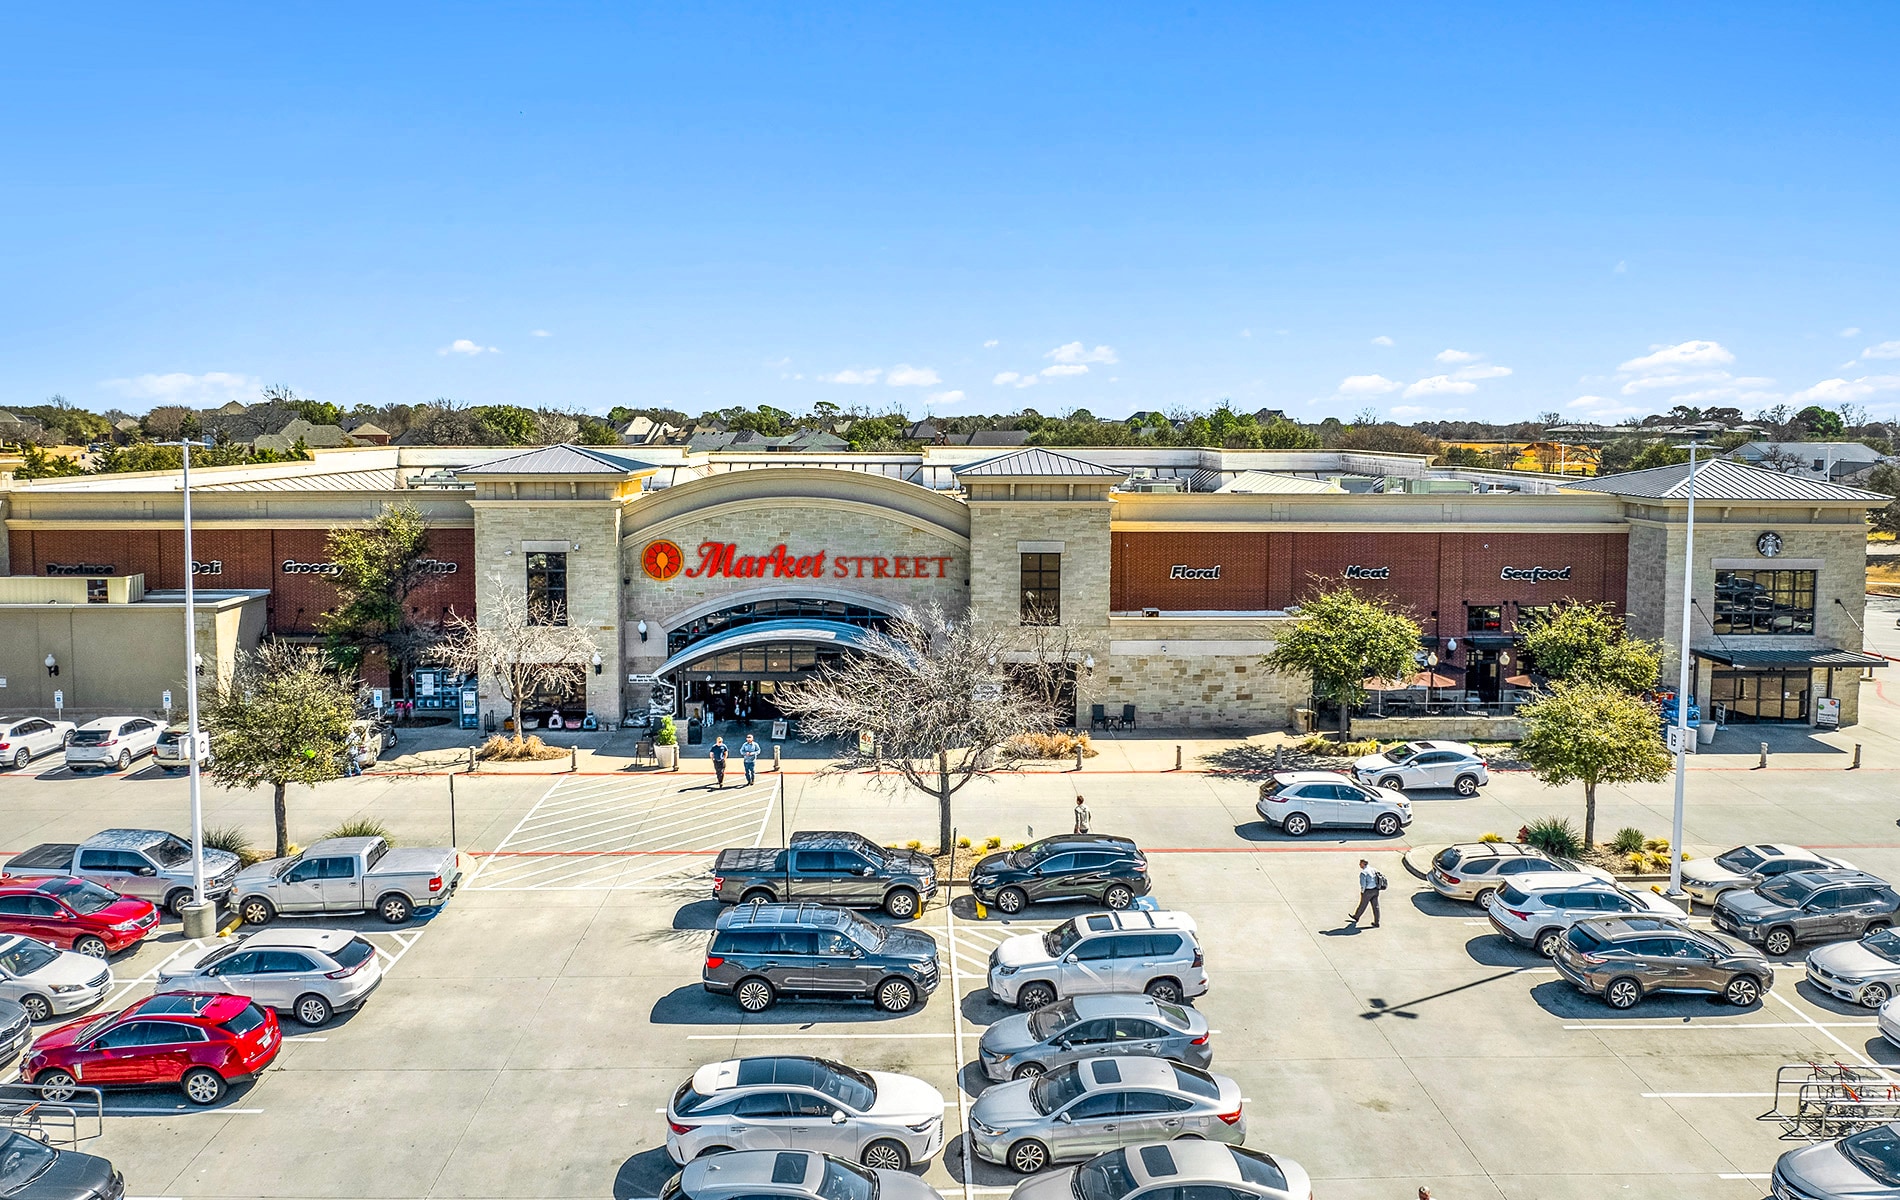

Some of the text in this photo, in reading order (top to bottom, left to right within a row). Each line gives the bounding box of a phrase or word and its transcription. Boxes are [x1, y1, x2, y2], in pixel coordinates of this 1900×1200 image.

[685, 541, 953, 578] Market STREET
[46, 562, 115, 575] Produce
[192, 560, 222, 575] Deli
[282, 560, 345, 577] Grocery
[1170, 565, 1221, 579] Floral
[1345, 565, 1390, 579] Meat
[1500, 566, 1571, 584] Seafood
[200, 740, 206, 753] C
